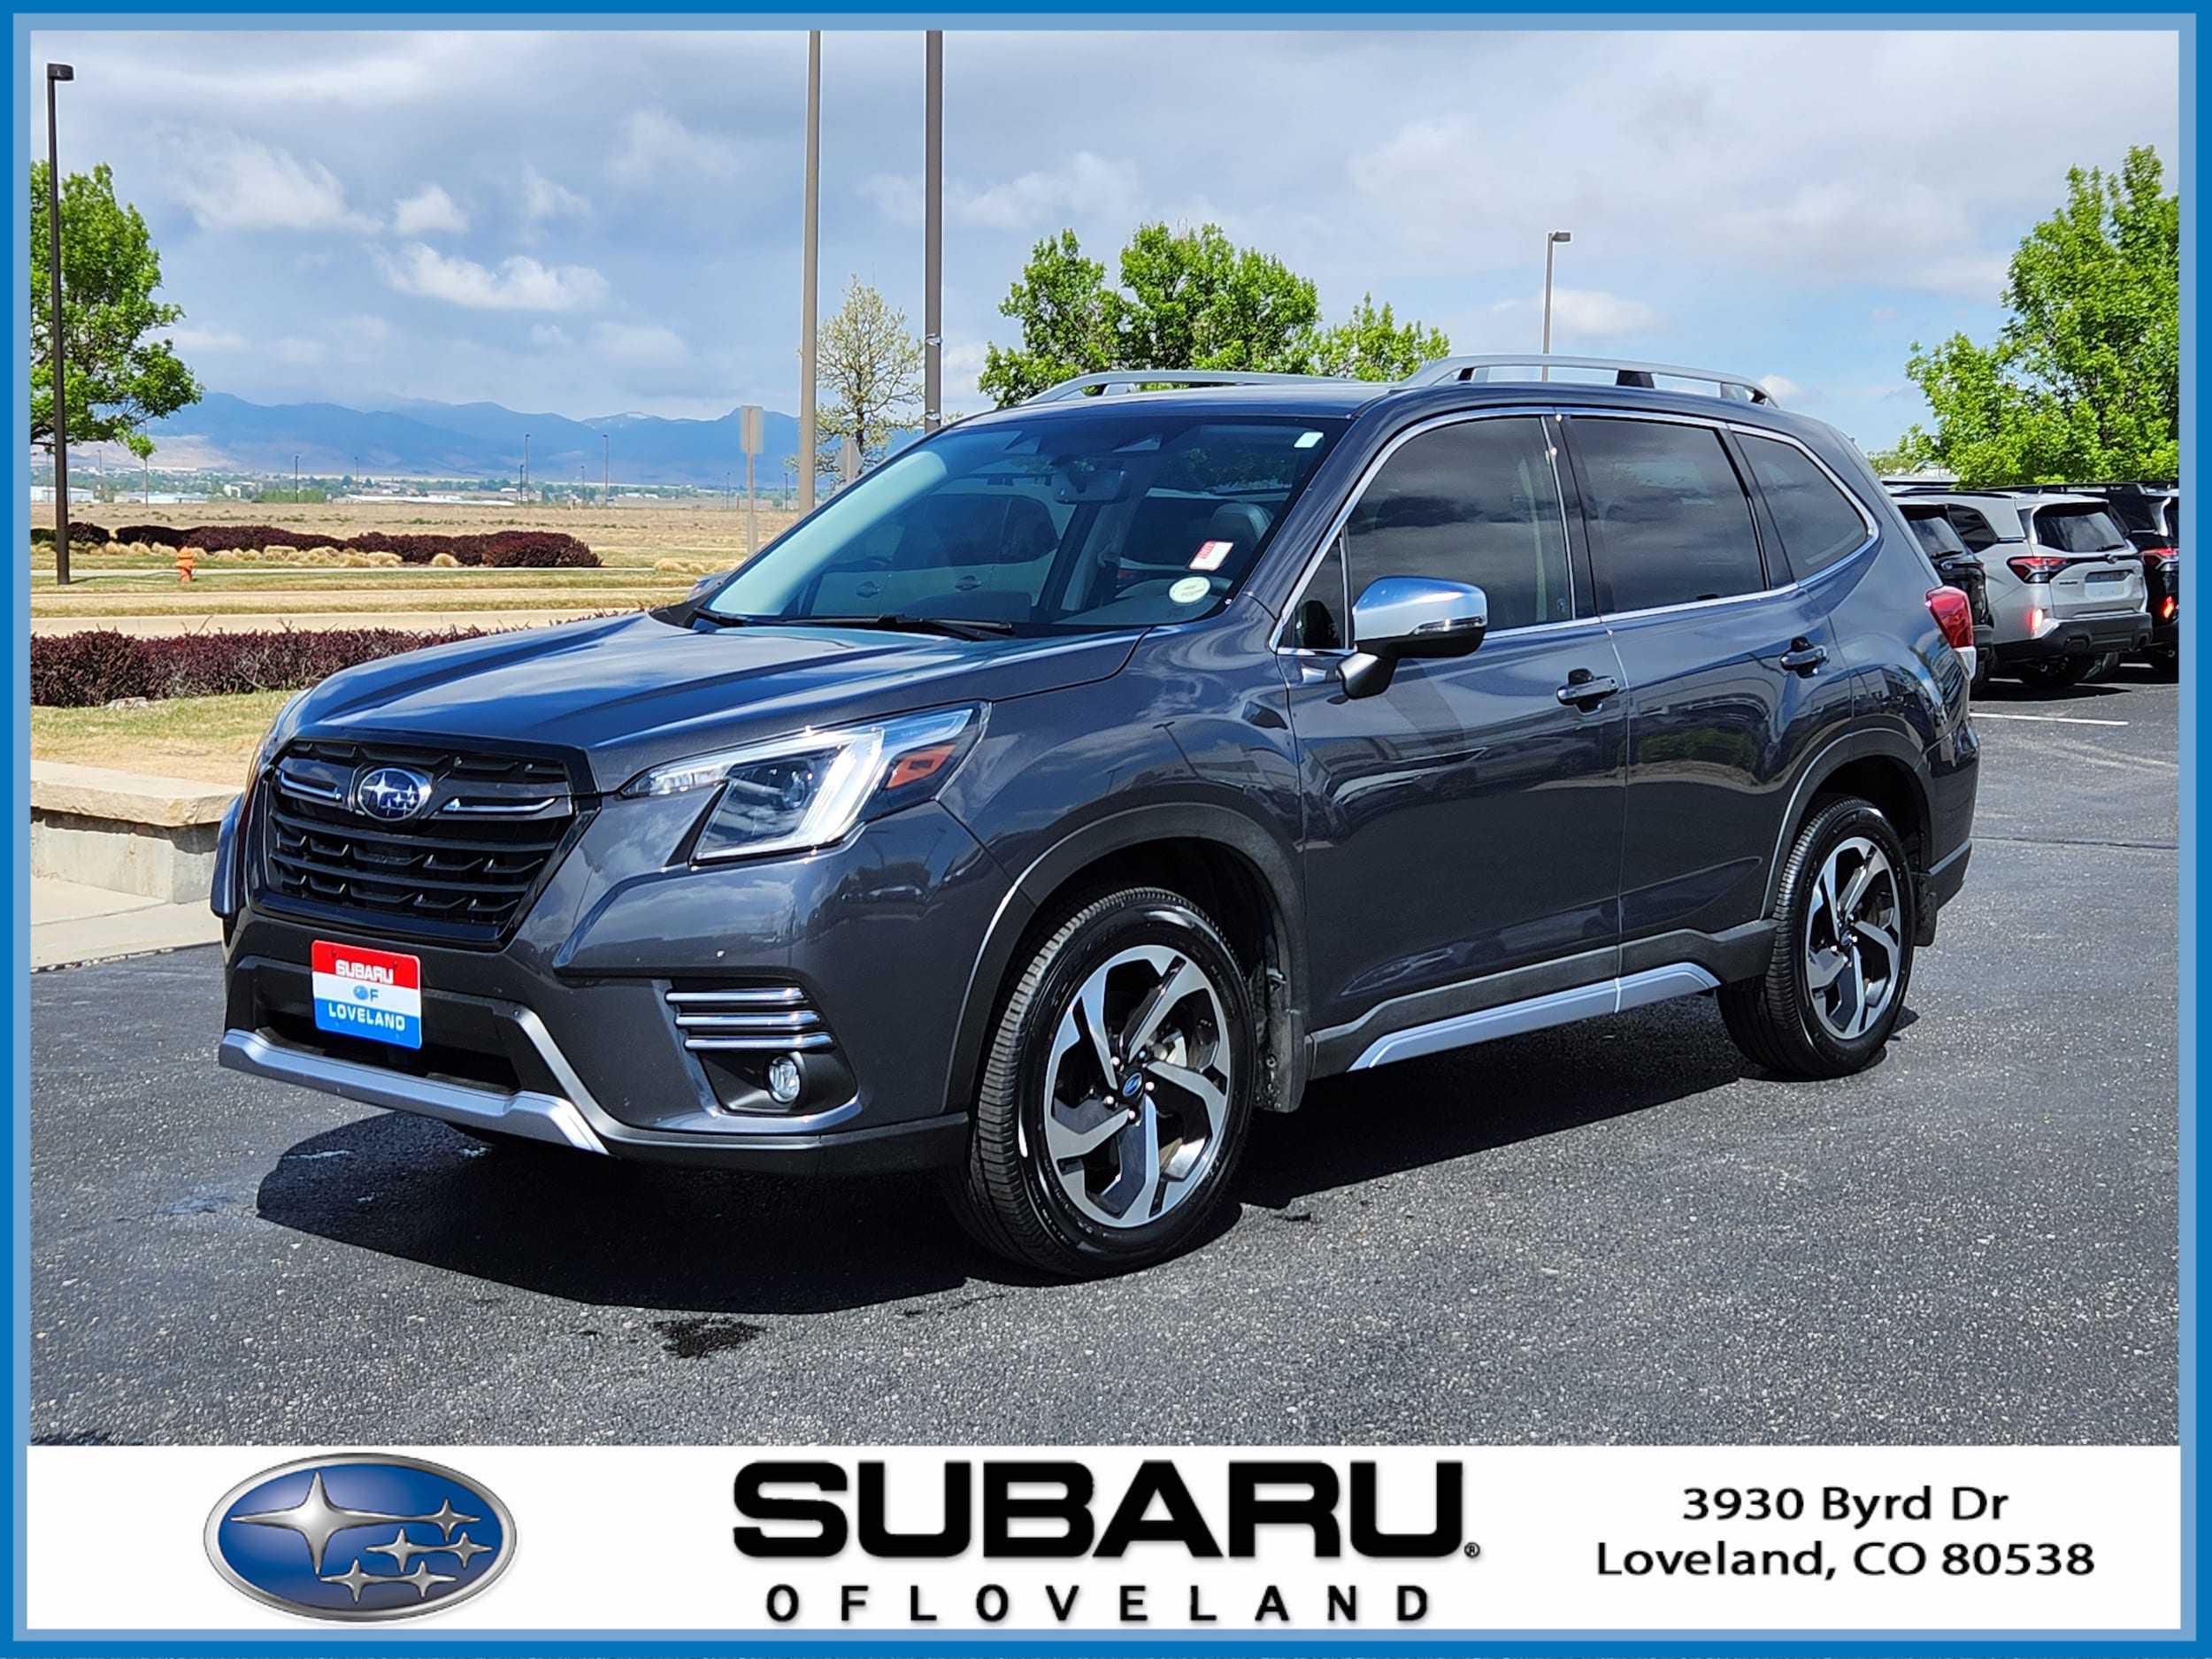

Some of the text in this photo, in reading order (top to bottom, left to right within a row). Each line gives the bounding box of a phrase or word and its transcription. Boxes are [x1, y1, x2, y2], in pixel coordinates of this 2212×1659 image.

[335, 959, 394, 984] SUBARU
[353, 985, 379, 1002] OF
[328, 1002, 405, 1032] LOVELAND
